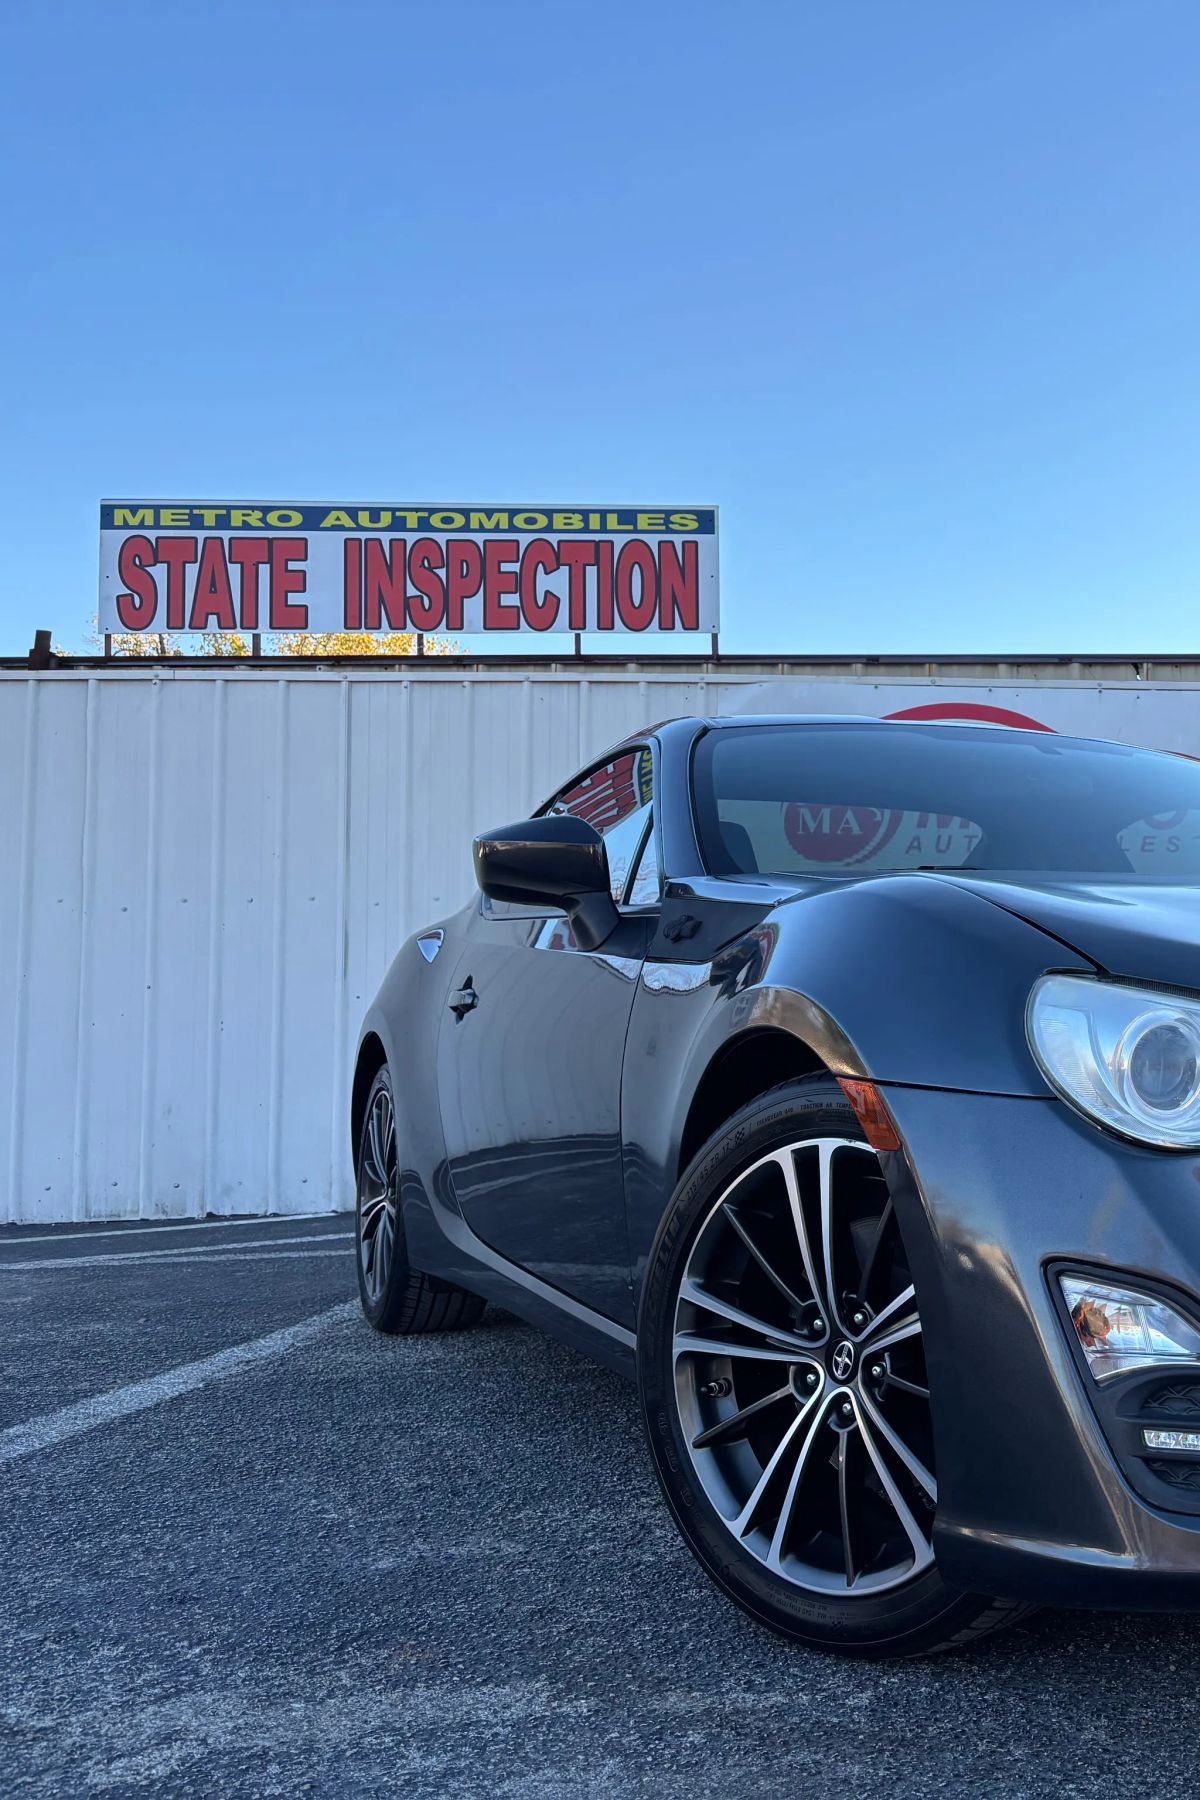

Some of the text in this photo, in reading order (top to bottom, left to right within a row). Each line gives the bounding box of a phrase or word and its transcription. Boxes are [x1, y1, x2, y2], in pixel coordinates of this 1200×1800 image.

[112, 507, 701, 532] METRO AUTOMOBILES
[115, 533, 700, 633] STATE INSPECTION
